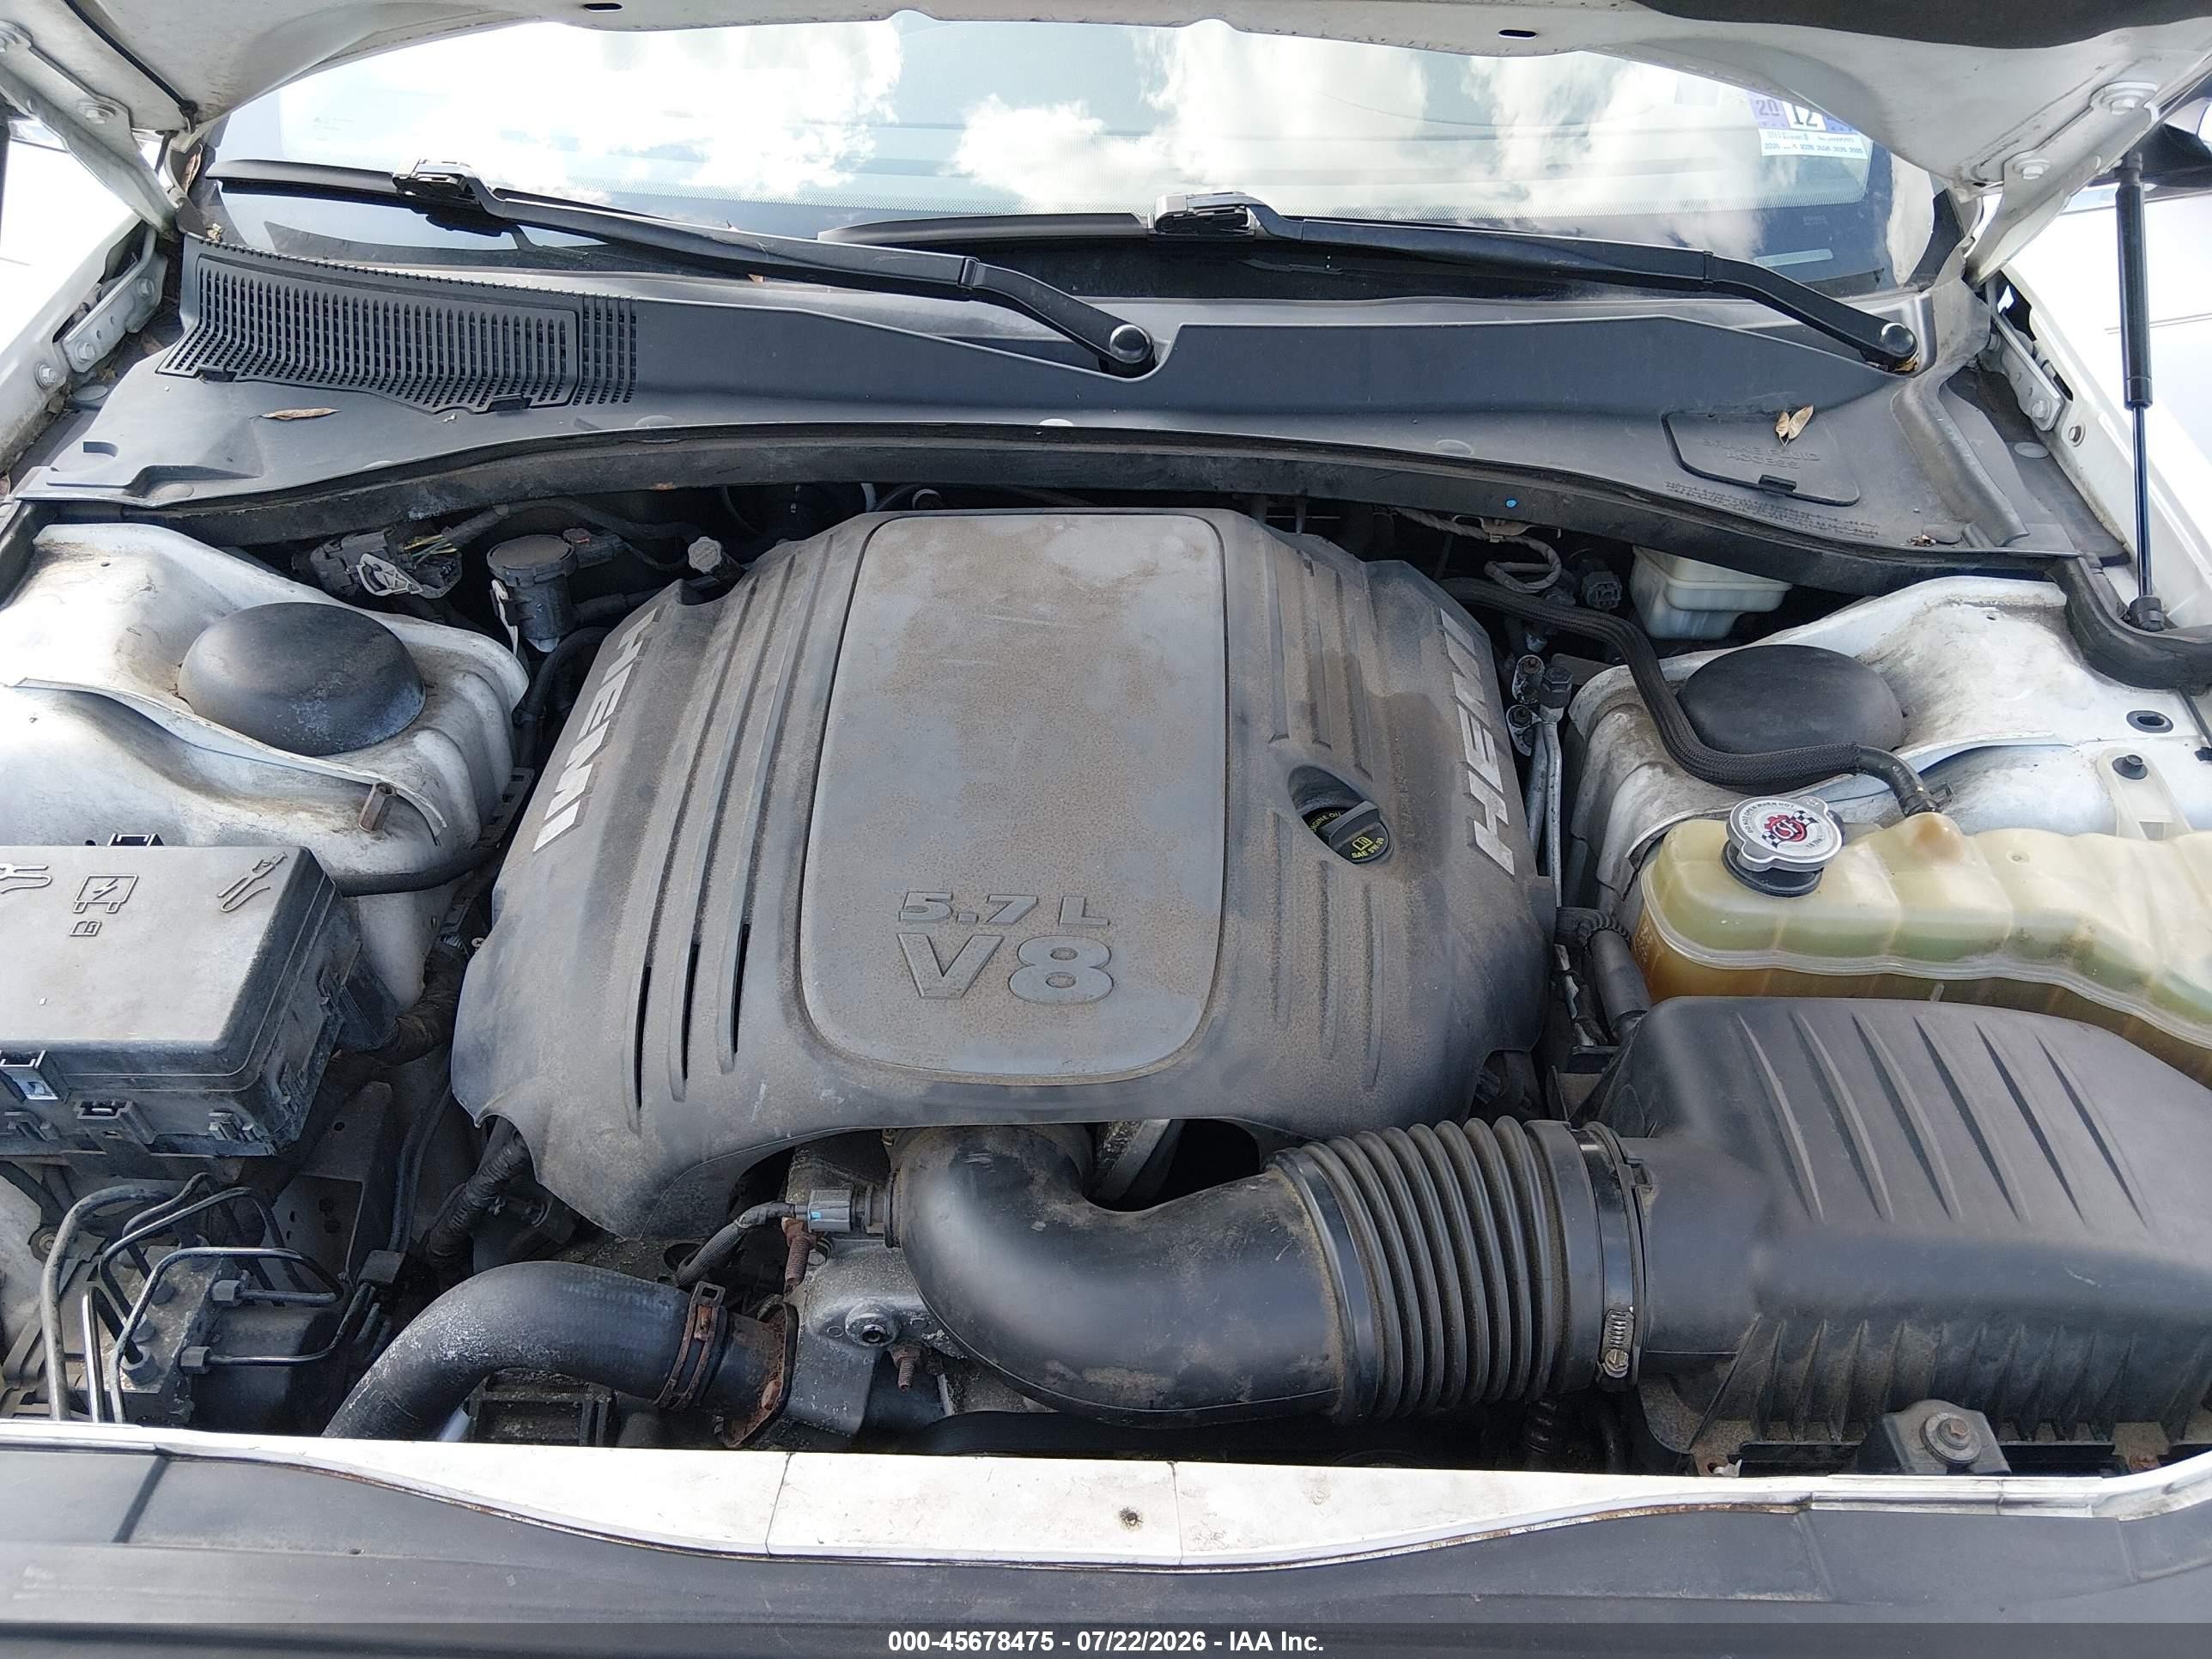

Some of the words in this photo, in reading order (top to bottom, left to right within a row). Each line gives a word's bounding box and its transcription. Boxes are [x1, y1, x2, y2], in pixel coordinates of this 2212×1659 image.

[1755, 99, 1780, 117] 20
[1702, 438, 1763, 455] BRAKE
[1768, 447, 1820, 462] FLUID
[1726, 452, 1801, 470] ACCESS
[532, 607, 658, 853] HEMI
[1440, 608, 1516, 876] HEMI
[1771, 818, 1799, 840] CSF
[1351, 851, 1369, 860] SAE
[898, 891, 1039, 926] 5.7
[1058, 894, 1111, 927] L
[896, 932, 1115, 1005] V8
